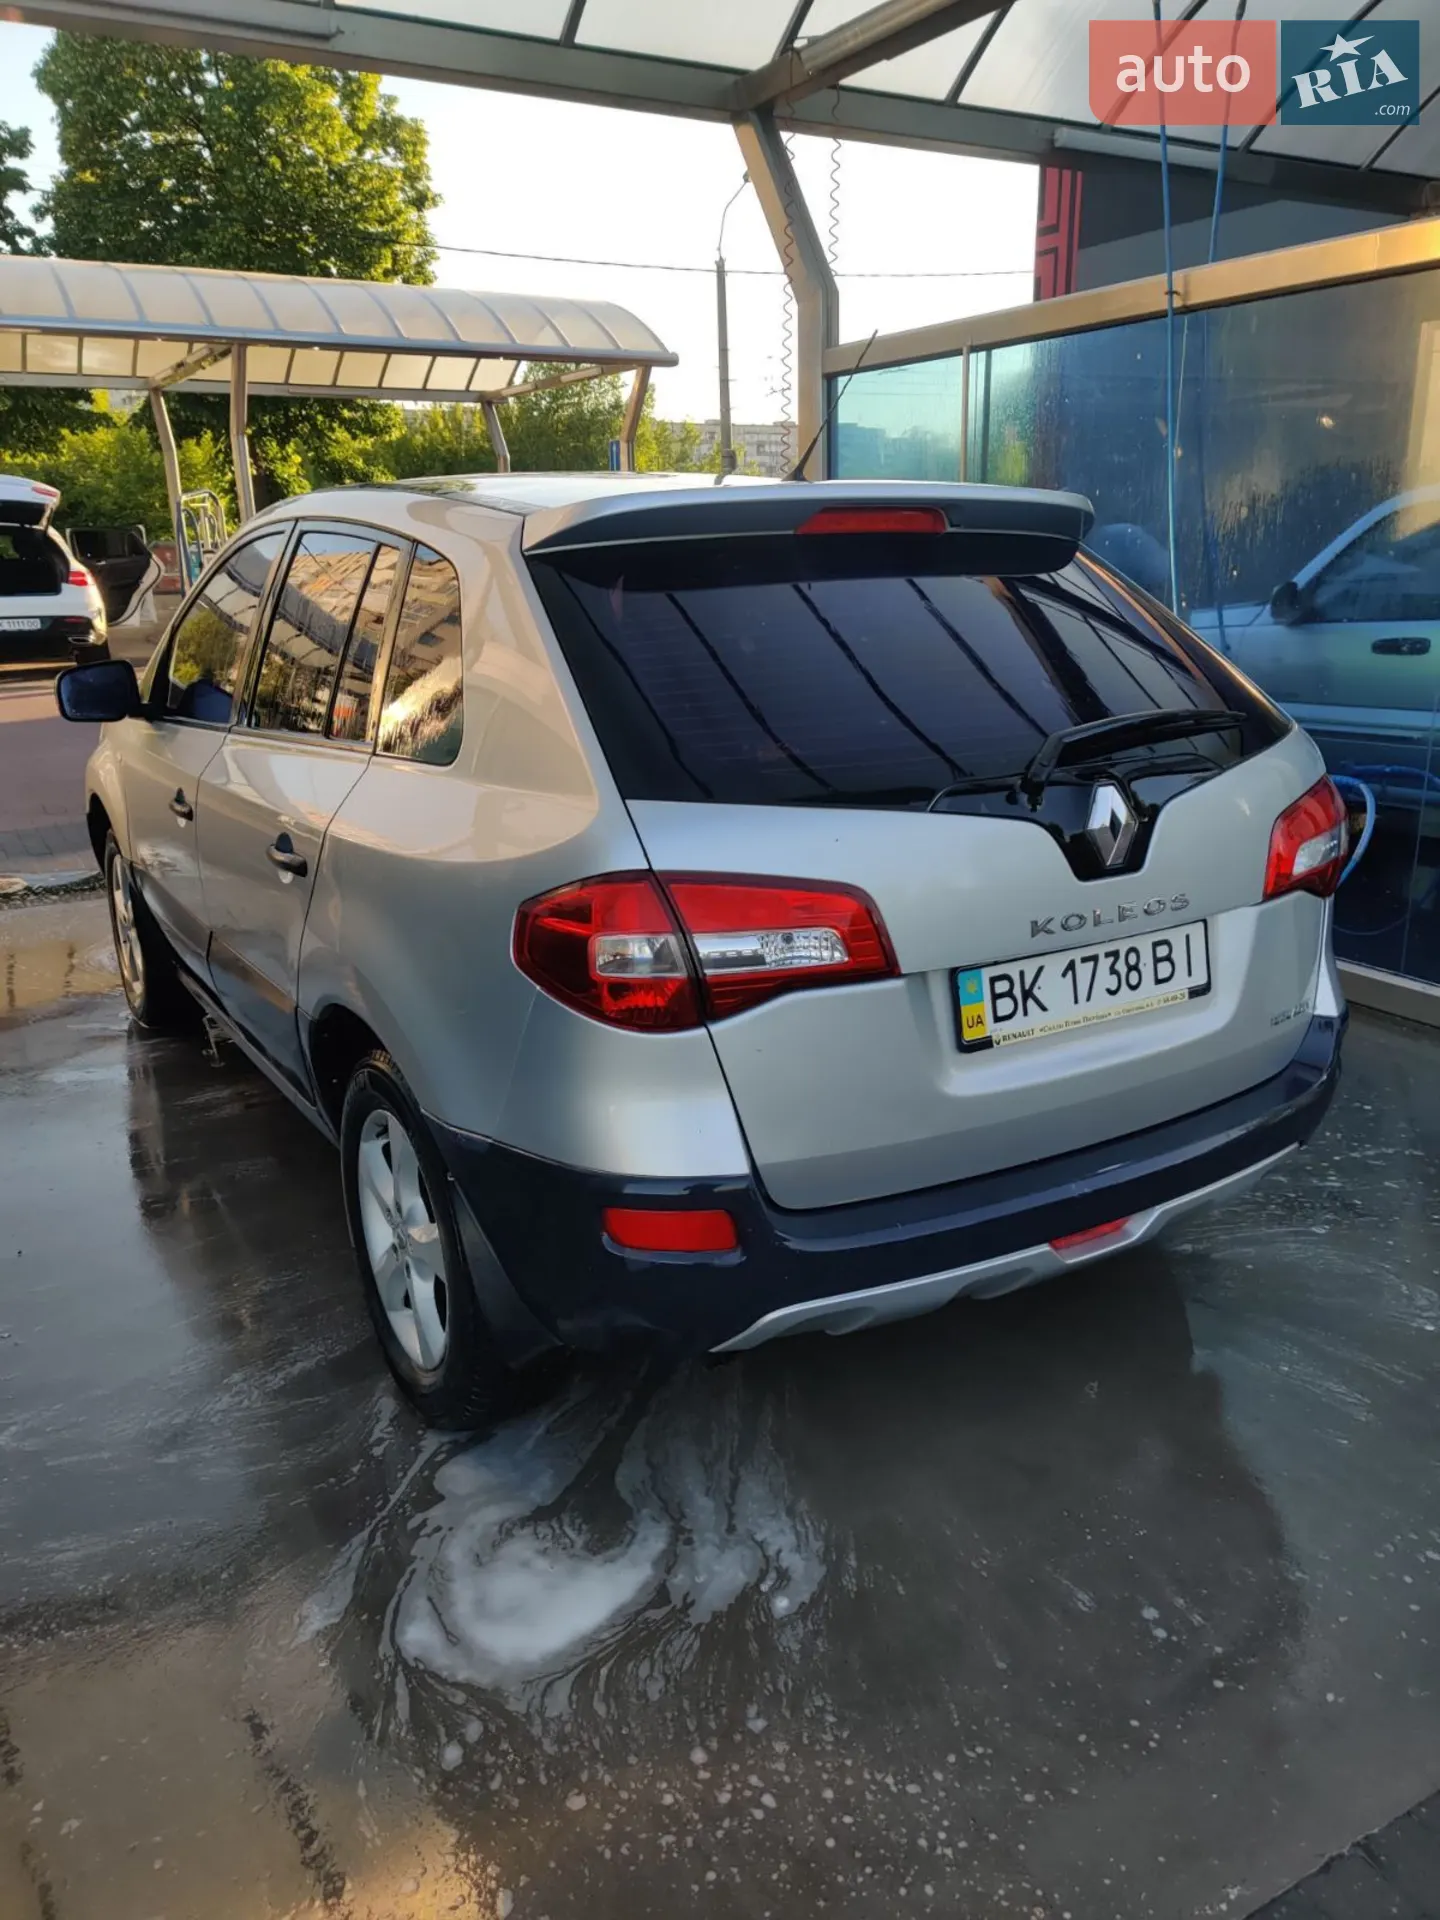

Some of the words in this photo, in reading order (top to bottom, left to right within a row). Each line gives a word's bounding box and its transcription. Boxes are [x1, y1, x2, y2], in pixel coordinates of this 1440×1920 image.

[1030, 893, 1190, 938] KOLEOS
[989, 965, 1049, 1023] BK
[1061, 946, 1142, 1005] 1738
[1151, 933, 1192, 985] BI
[966, 1013, 985, 1029] UA
